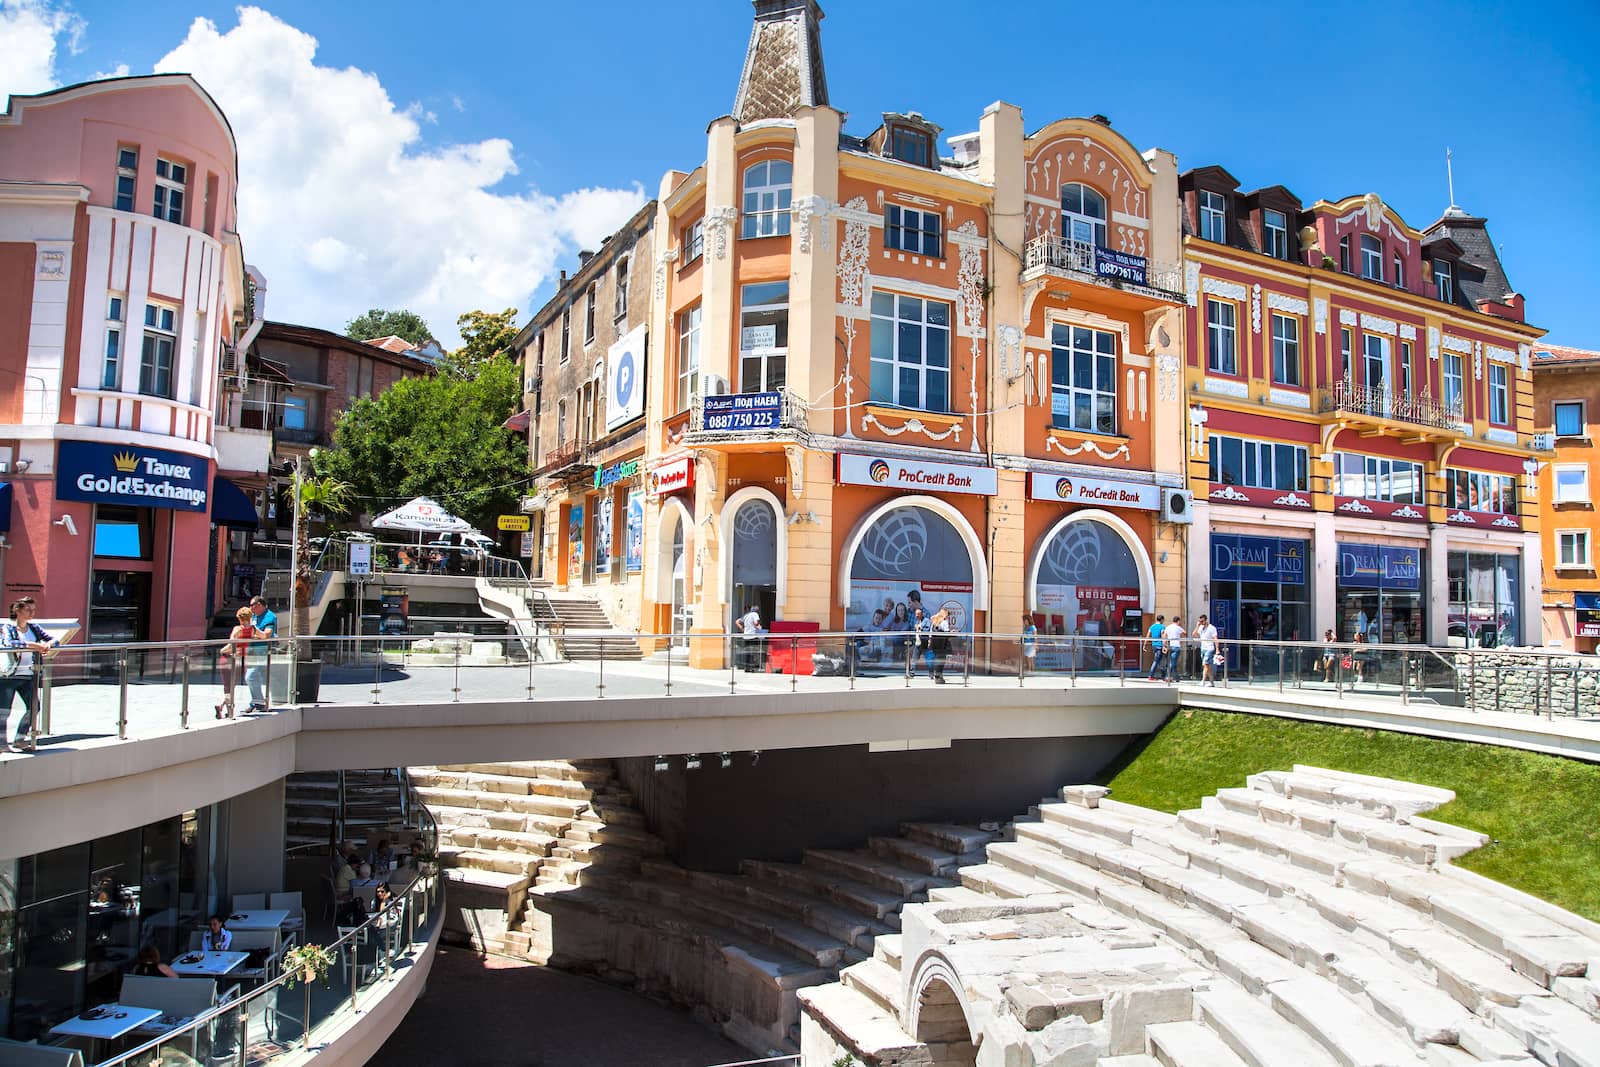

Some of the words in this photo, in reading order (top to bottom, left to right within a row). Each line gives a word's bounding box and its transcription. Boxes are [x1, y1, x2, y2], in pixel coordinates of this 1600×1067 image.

[735, 398, 753, 408] ПОД
[754, 396, 778, 406] НАЕМ
[709, 414, 733, 428] 0887
[734, 413, 752, 426] 750
[754, 412, 773, 426] 225
[142, 457, 191, 480] Tavex
[898, 468, 945, 485] ProCredit
[947, 473, 972, 487] Bank
[1080, 486, 1118, 501] ProCredit
[1119, 490, 1140, 503] Bank
